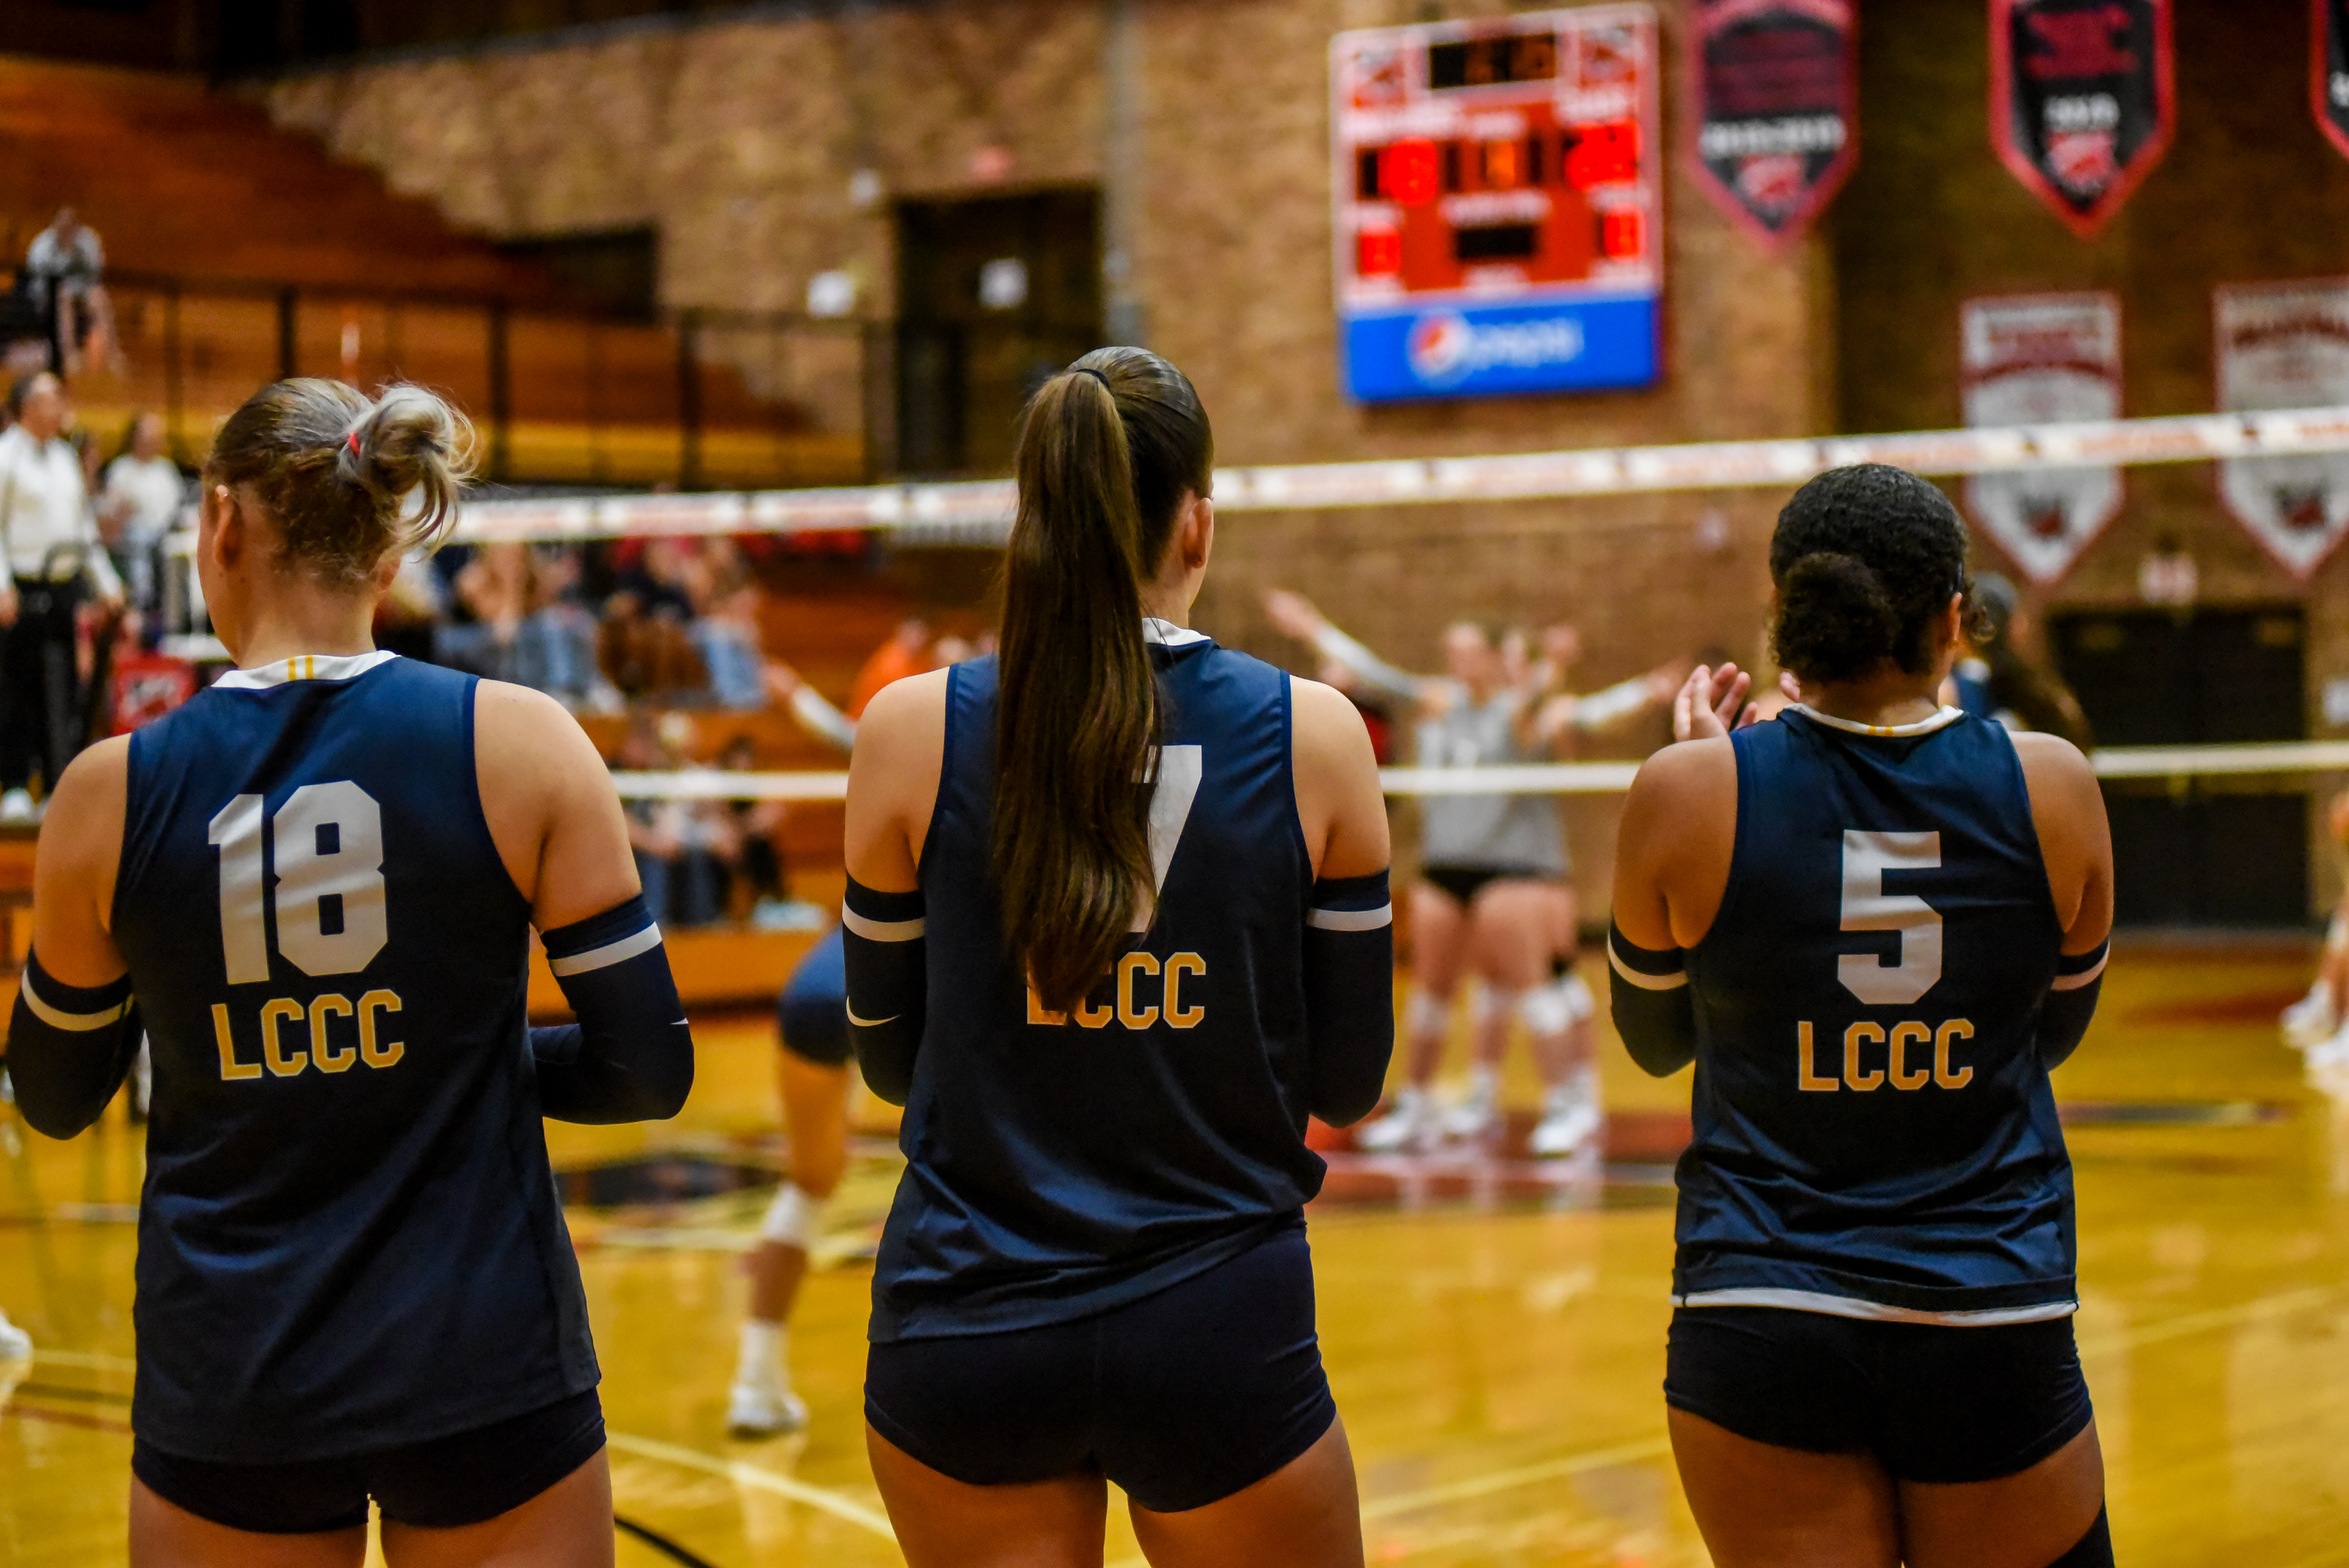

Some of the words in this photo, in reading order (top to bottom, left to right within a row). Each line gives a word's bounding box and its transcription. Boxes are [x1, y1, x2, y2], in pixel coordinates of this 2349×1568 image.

[208, 779, 388, 985] 18
[1128, 744, 1203, 933] 7
[1838, 829, 1943, 1005] 5
[211, 988, 405, 1081] LCCC
[1798, 1018, 1975, 1091] LCCC
